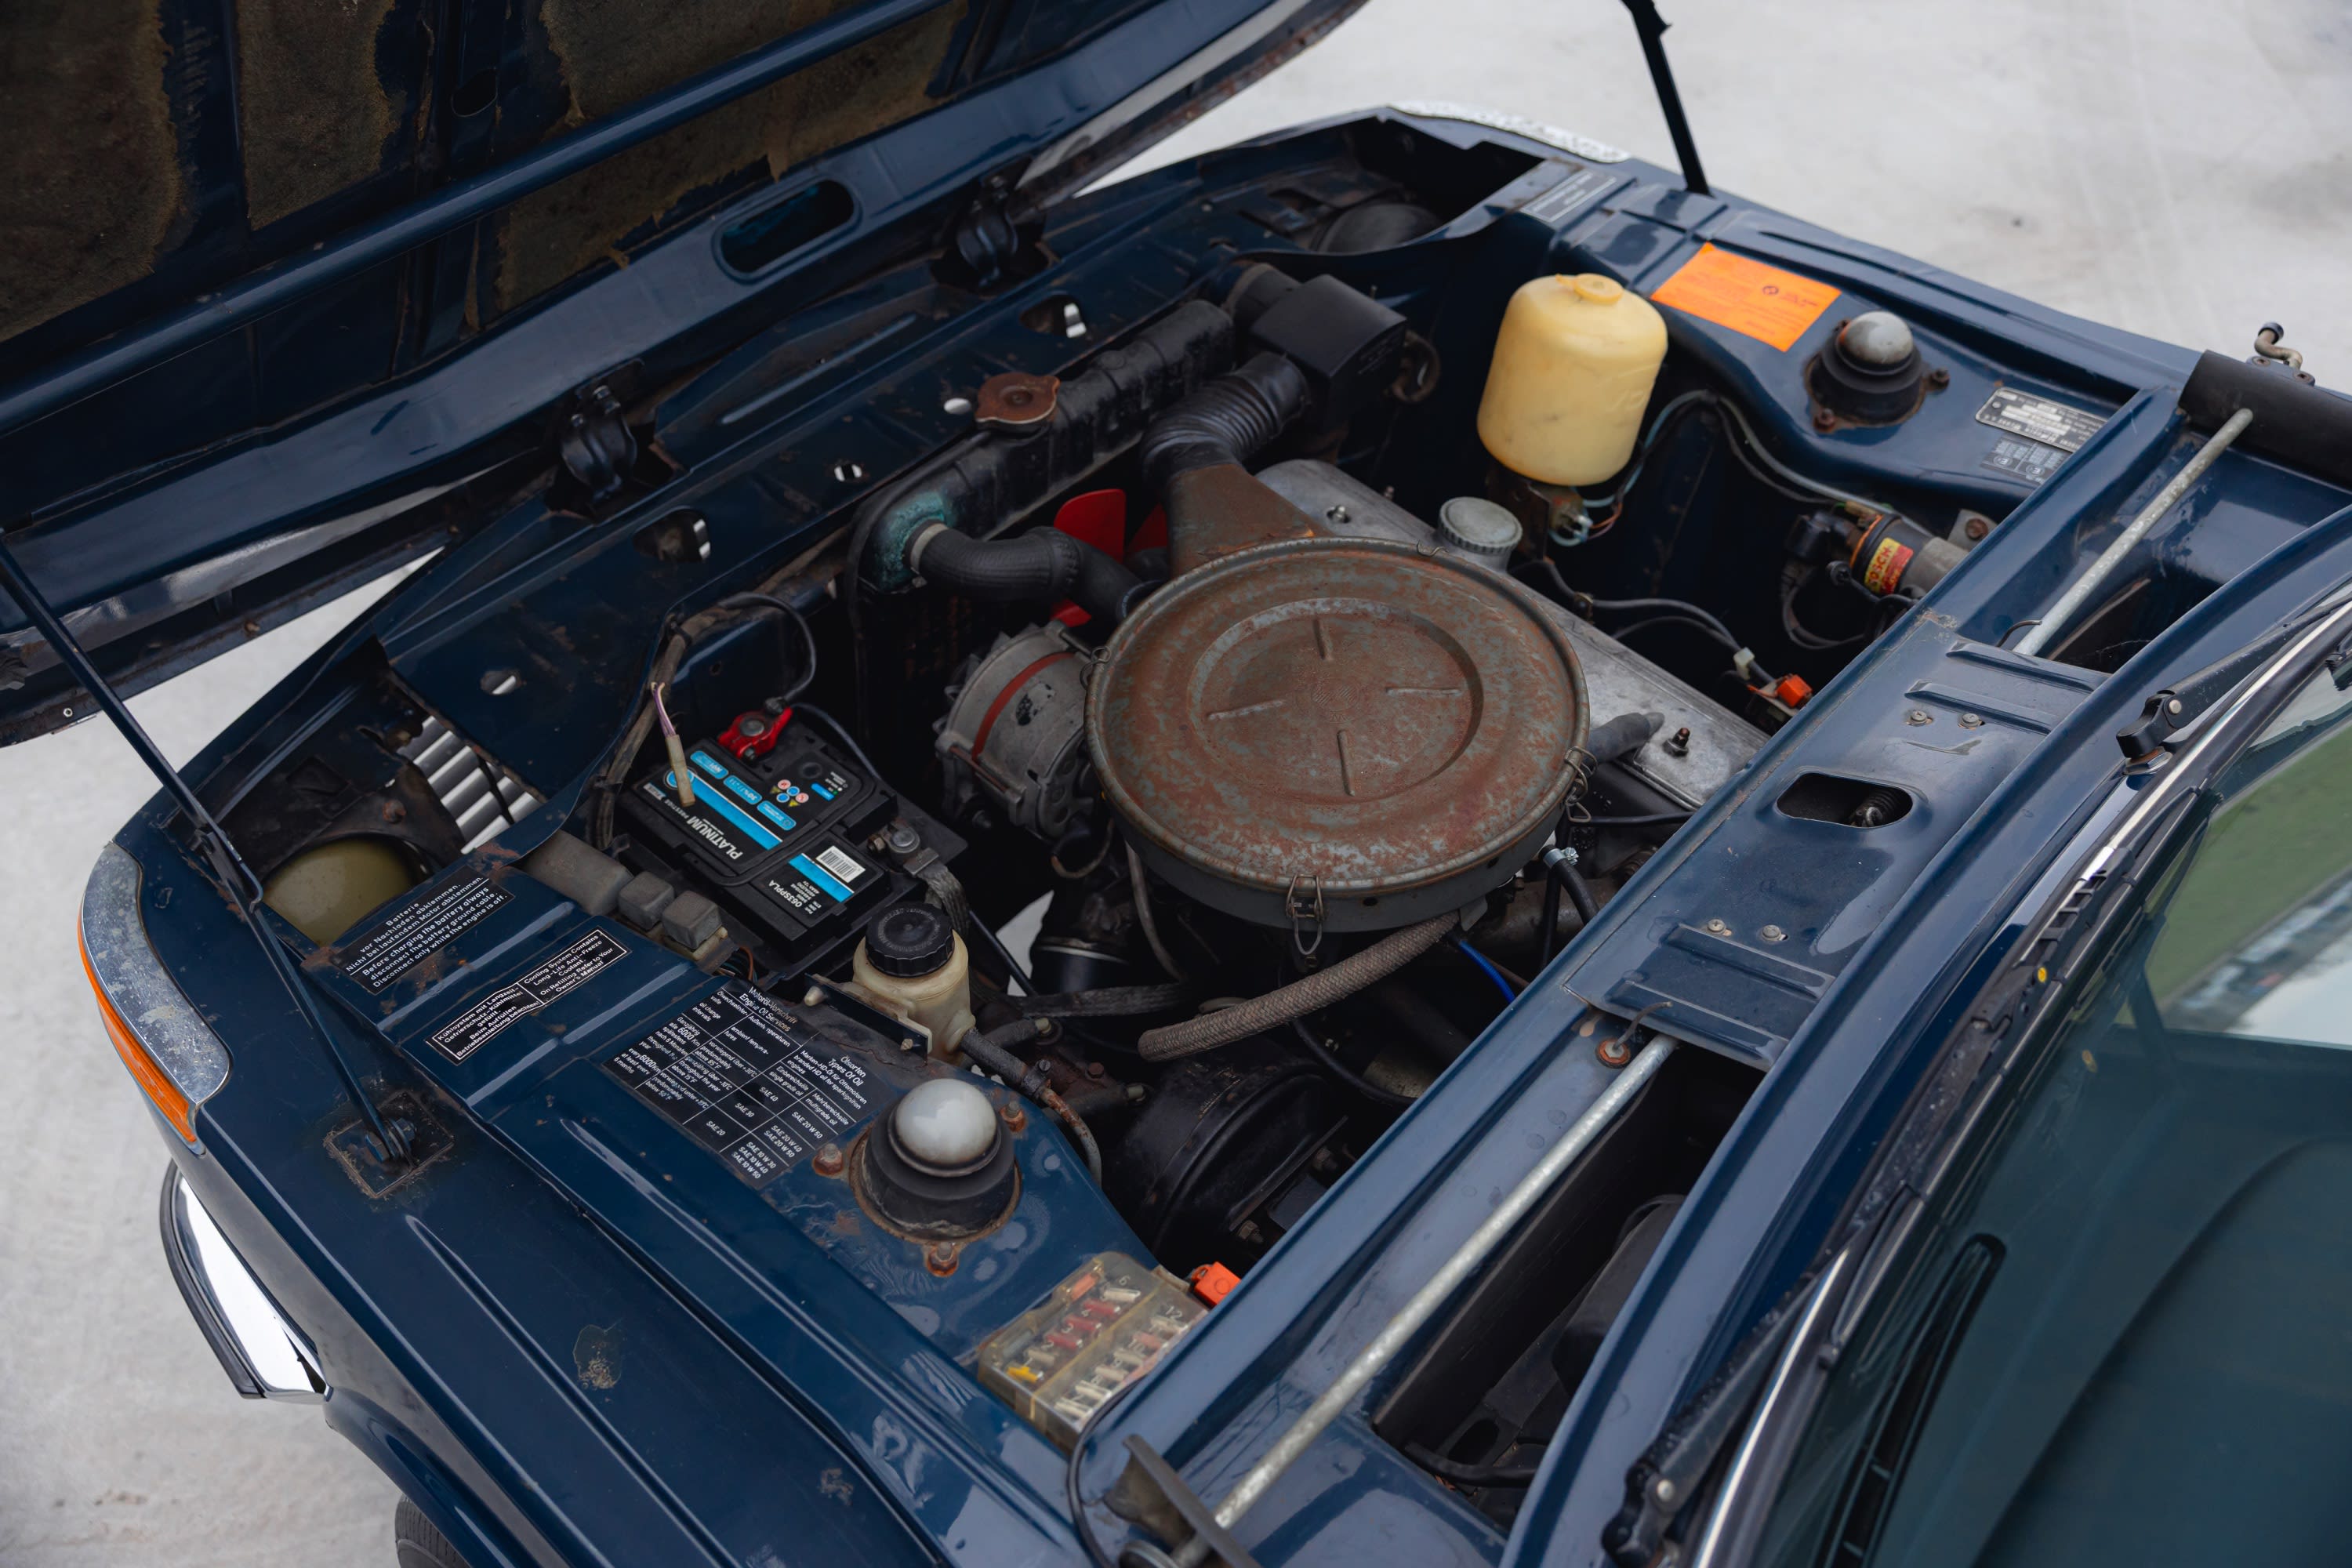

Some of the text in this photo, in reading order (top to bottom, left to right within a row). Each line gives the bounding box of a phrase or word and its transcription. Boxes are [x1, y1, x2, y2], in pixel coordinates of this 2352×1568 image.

[687, 816, 743, 859] PLATINUM
[769, 880, 802, 907] 063SPPLA
[360, 885, 460, 953] vor Nachladen abklemmen.
[386, 903, 419, 926] Batterie
[346, 877, 483, 971] Nicht bei laufendem Motor abklemmen.
[362, 887, 489, 975] Before charging the battery always
[371, 893, 498, 980] disconnect the battery ground cable.
[372, 958, 414, 987] Disconnect
[415, 948, 430, 959] only
[430, 934, 451, 948] while
[449, 925, 463, 935] the
[463, 909, 486, 926] engine
[493, 895, 507, 905] off.
[524, 935, 598, 984] Cooling System Contains
[550, 972, 577, 989] Refilling
[575, 961, 593, 973] Refer
[599, 948, 613, 957] Your
[558, 960, 586, 976] Coolant.
[555, 960, 604, 992] Owner's Manual
[437, 1013, 476, 1040] Kühlsystem
[476, 1004, 488, 1014] mit
[477, 1011, 501, 1027] gefüllt.
[692, 1006, 711, 1022] intervals
[705, 1007, 720, 1019] change
[758, 1007, 769, 1016] Oil
[765, 1013, 791, 1032] Services
[469, 1006, 517, 1040] Beim Auffüllen
[677, 1017, 701, 1036] Ganzjährig
[456, 1017, 514, 1057] Betriebsanleitung
[677, 1026, 697, 1040] 6000
[724, 1030, 737, 1041] tures
[731, 1026, 750, 1040] ambient
[647, 1036, 671, 1054] throughout
[655, 1031, 667, 1040] nach
[669, 1040, 688, 1055] Monaten
[629, 1048, 641, 1058] every
[639, 1054, 656, 1067] 6000
[695, 1051, 709, 1061] above
[709, 1041, 735, 1061] vorwiegend
[732, 1058, 744, 1068] über
[793, 1054, 815, 1070] branded
[617, 1060, 634, 1073] months
[626, 1056, 639, 1065] least
[637, 1065, 650, 1075] every
[671, 1065, 686, 1076] above
[679, 1060, 704, 1079] throughout
[787, 1060, 806, 1074] engines
[829, 1058, 847, 1073] Types
[852, 1077, 864, 1087] Oil
[840, 1055, 866, 1078] Ölsorten
[645, 1080, 660, 1092] below
[708, 1073, 720, 1081] über
[769, 1071, 784, 1083] single
[781, 1081, 797, 1092] grade
[776, 1065, 809, 1091] Einbereichsöle
[684, 1090, 697, 1100] unter
[759, 1087, 773, 1097] SAE
[839, 1079, 867, 1105] Ottomotoren
[735, 1103, 749, 1113] SAE
[805, 1098, 830, 1120] multigrade
[812, 1093, 849, 1125] Mehrbereichsöle
[706, 1121, 720, 1131] SAE
[792, 1112, 805, 1123] SAE
[764, 1131, 778, 1142] SAE
[771, 1125, 785, 1137] SAE
[739, 1146, 753, 1158] SAE
[746, 1142, 760, 1153] SAE
[732, 1152, 745, 1163] SAE
[1118, 1275, 1131, 1286] 6
[1165, 1305, 1183, 1319] 12
[1061, 1323, 1074, 1334] 3
